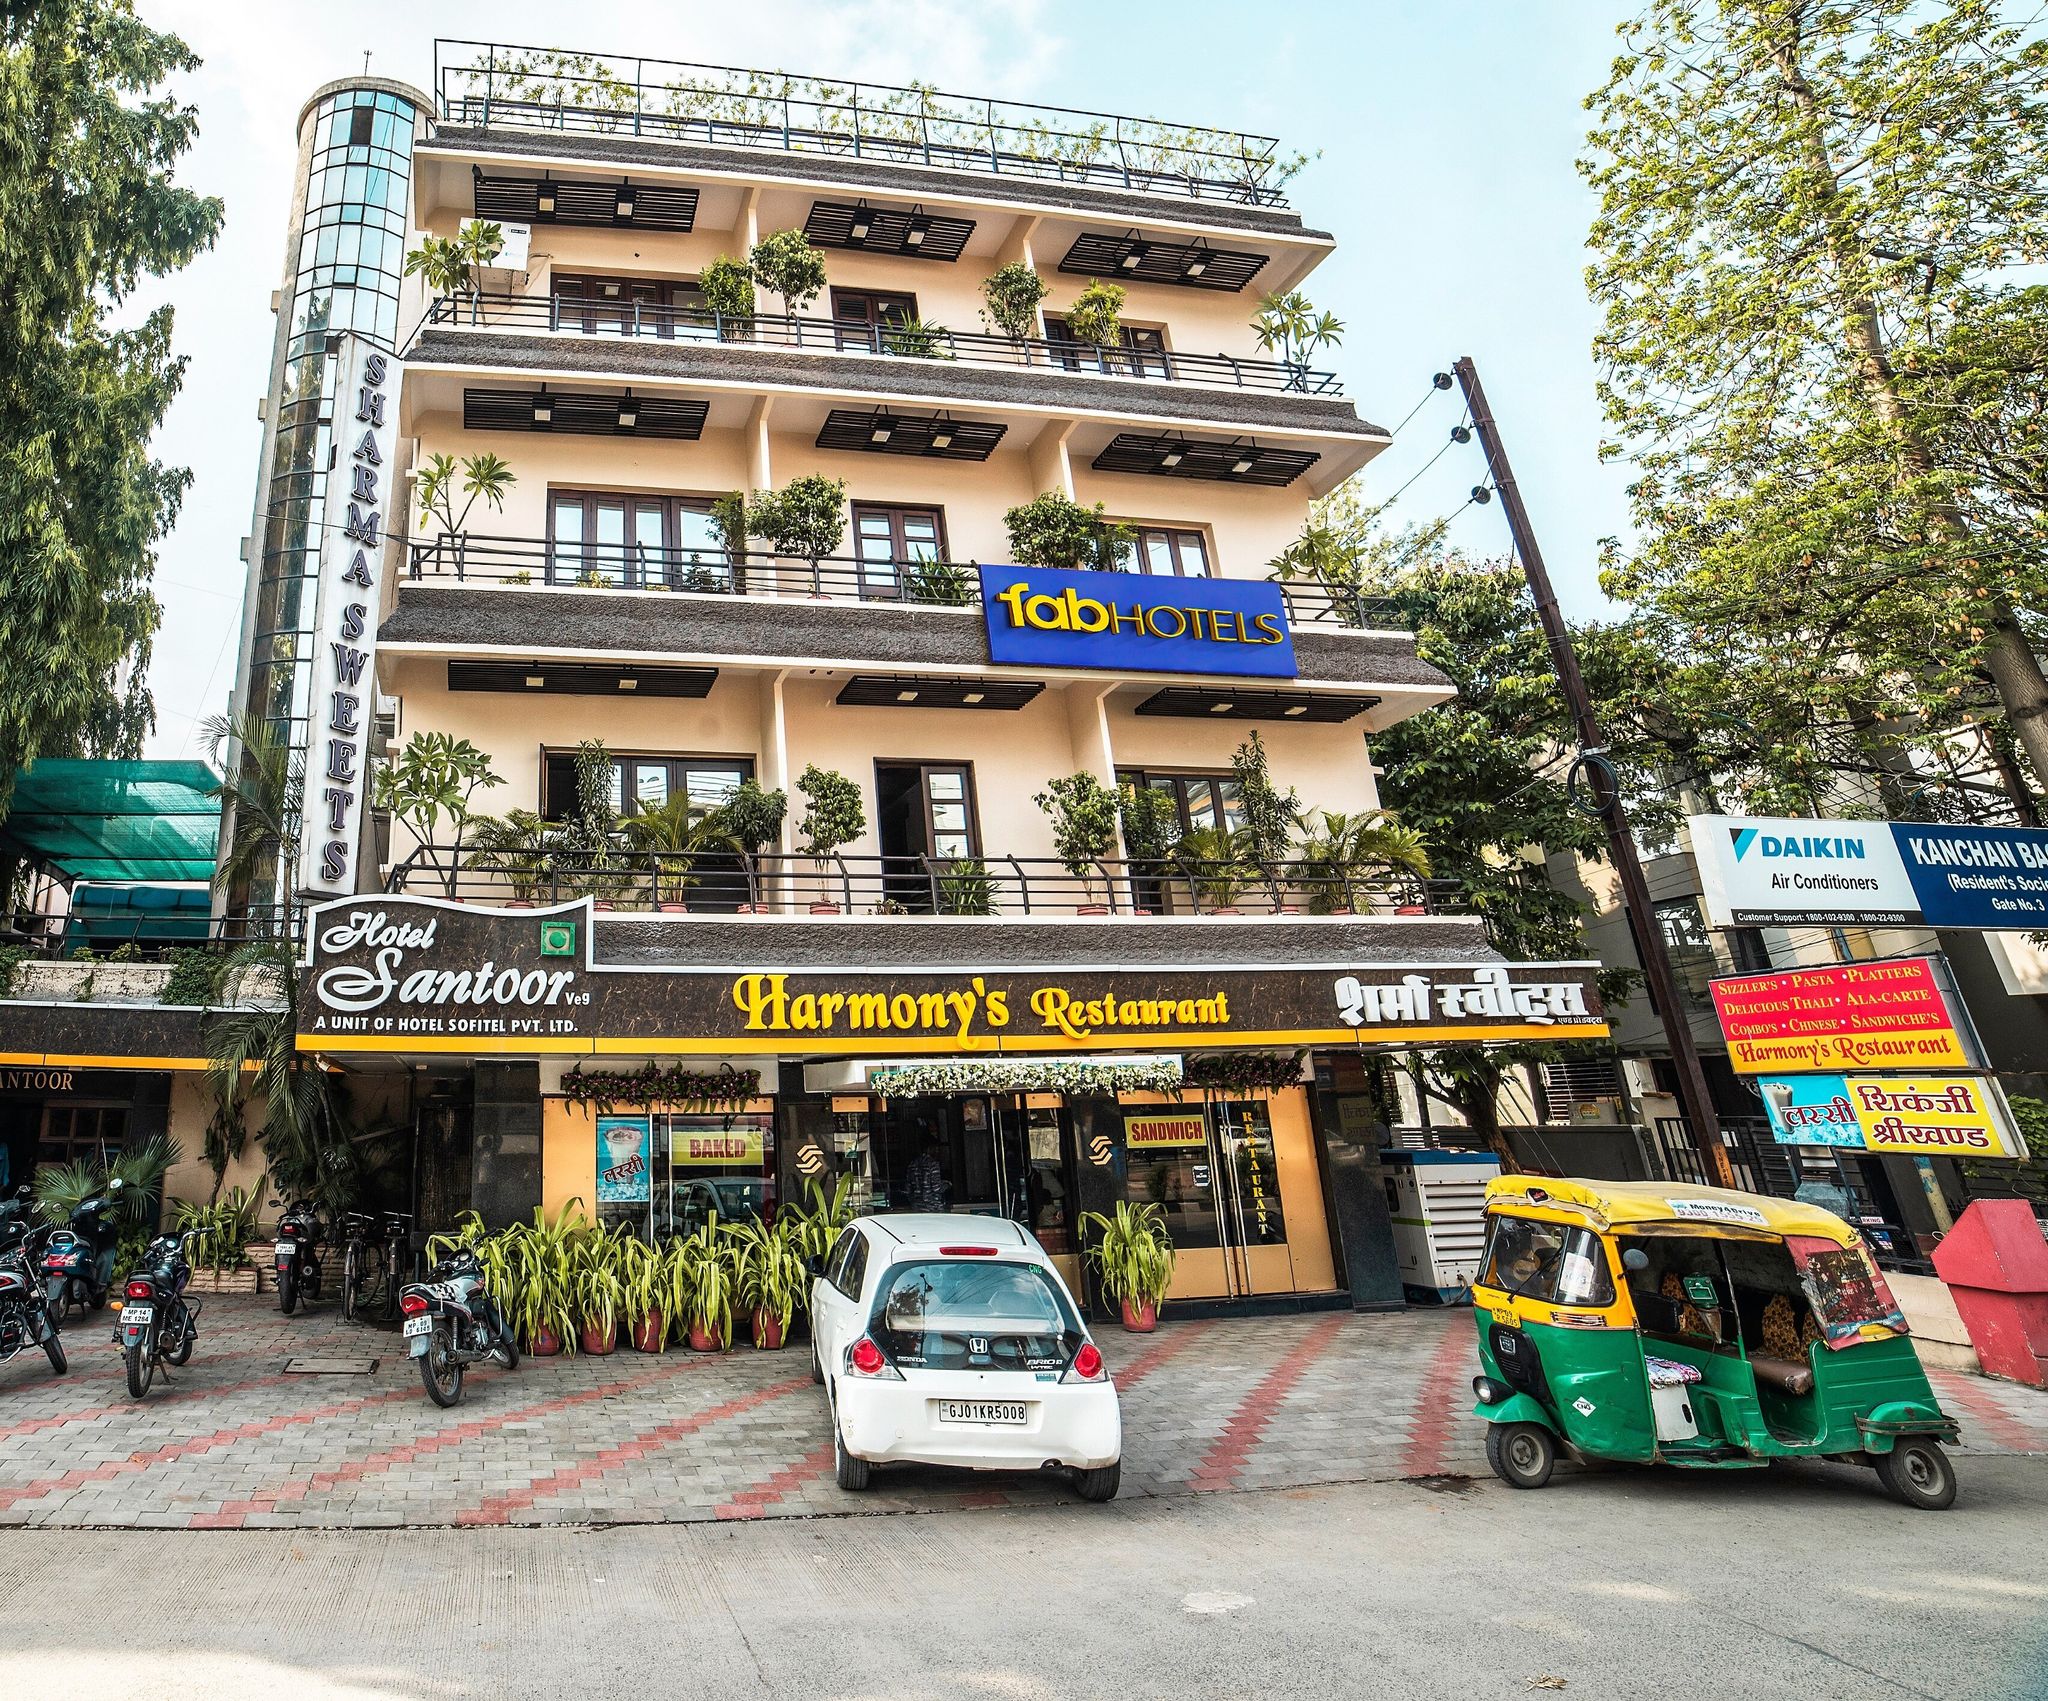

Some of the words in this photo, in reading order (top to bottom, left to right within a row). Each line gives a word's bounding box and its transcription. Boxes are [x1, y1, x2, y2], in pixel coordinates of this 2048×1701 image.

[342, 351, 388, 588] SHARMA
[321, 602, 370, 882] SWEETS
[1761, 836, 1866, 859] DAIKIN
[1908, 837, 2019, 868] KANCHAN
[2015, 842, 2048, 869] BA
[1771, 872, 1790, 889] Air
[1793, 872, 1879, 890] Conditioners
[1737, 912, 1773, 922] Customer
[1774, 913, 1805, 923] Support:
[1992, 897, 2017, 911] Gate
[2017, 898, 2037, 912] No.
[2038, 899, 2046, 911] 3
[320, 911, 437, 953] Hotel
[316, 948, 575, 1012] Santoor
[564, 992, 590, 1005] Veg
[1718, 980, 1778, 996] SIZZLER'S
[1791, 974, 1835, 988] PASTA
[1846, 965, 1922, 983] PLATTERS
[733, 974, 1010, 1051] Harmony's
[1031, 987, 1231, 1040] Restaurant
[1723, 1000, 1790, 1016] DELICIOUS
[1790, 996, 1834, 1010] THALI
[1847, 989, 1931, 1006] ALA-CARTE
[315, 1016, 327, 1029] A
[331, 1017, 369, 1030] UNIT
[373, 1018, 394, 1031] OF
[398, 1018, 444, 1032] HOTEL
[448, 1018, 507, 1032] SOFITEL
[511, 1019, 545, 1033] PVT.
[549, 1019, 579, 1033] LTD.
[1730, 1022, 1778, 1036] COMBO'S
[1789, 1018, 1840, 1033] CHINESE
[1850, 1012, 1940, 1029] SANDWICHE'S
[1736, 1038, 1831, 1067] Harmony's
[1833, 1034, 1951, 1066] Restaurant
[1857, 1084, 1978, 1115] शिकंजी
[1131, 1120, 1203, 1142] SANDWICH
[689, 1138, 747, 1159] BAKED
[1241, 1111, 1269, 1235] RESTAURANT
[896, 1355, 928, 1363] HONDA
[949, 1404, 1025, 1420] GJ01KR5008
